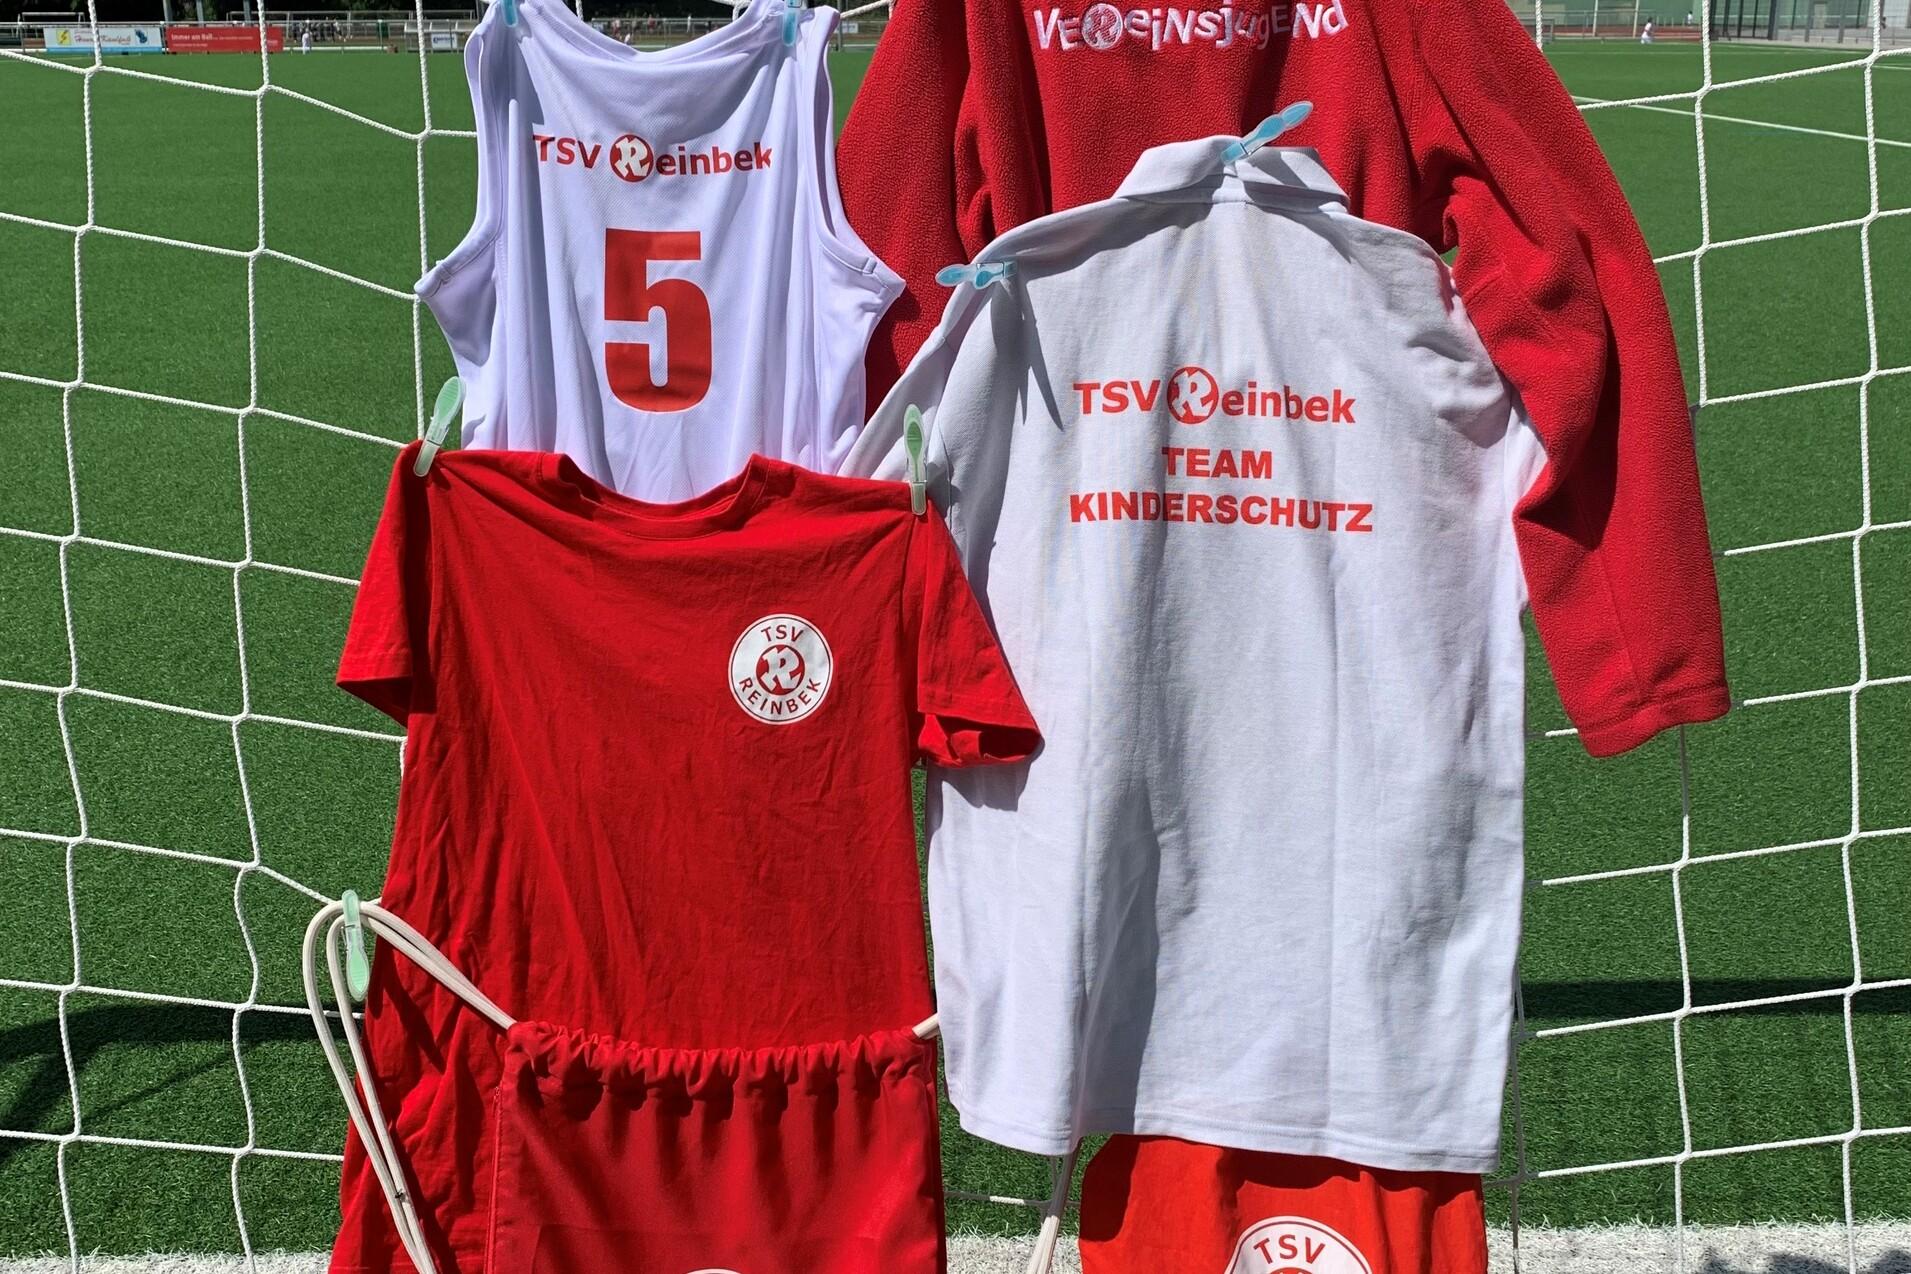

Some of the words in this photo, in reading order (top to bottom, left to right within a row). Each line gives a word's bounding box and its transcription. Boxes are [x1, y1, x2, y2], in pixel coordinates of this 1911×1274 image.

[532, 134, 602, 169] TSV
[609, 133, 773, 183] Reinbek
[604, 227, 713, 413] 5
[1072, 379, 1161, 415] TSV
[1166, 366, 1356, 424] Reinbek
[1161, 446, 1273, 479] TEAM
[1069, 491, 1374, 532] KINDERSCHUTZ
[761, 624, 804, 642] TSV
[738, 677, 821, 715] REINBEK
[1253, 1234, 1326, 1265] TSV
